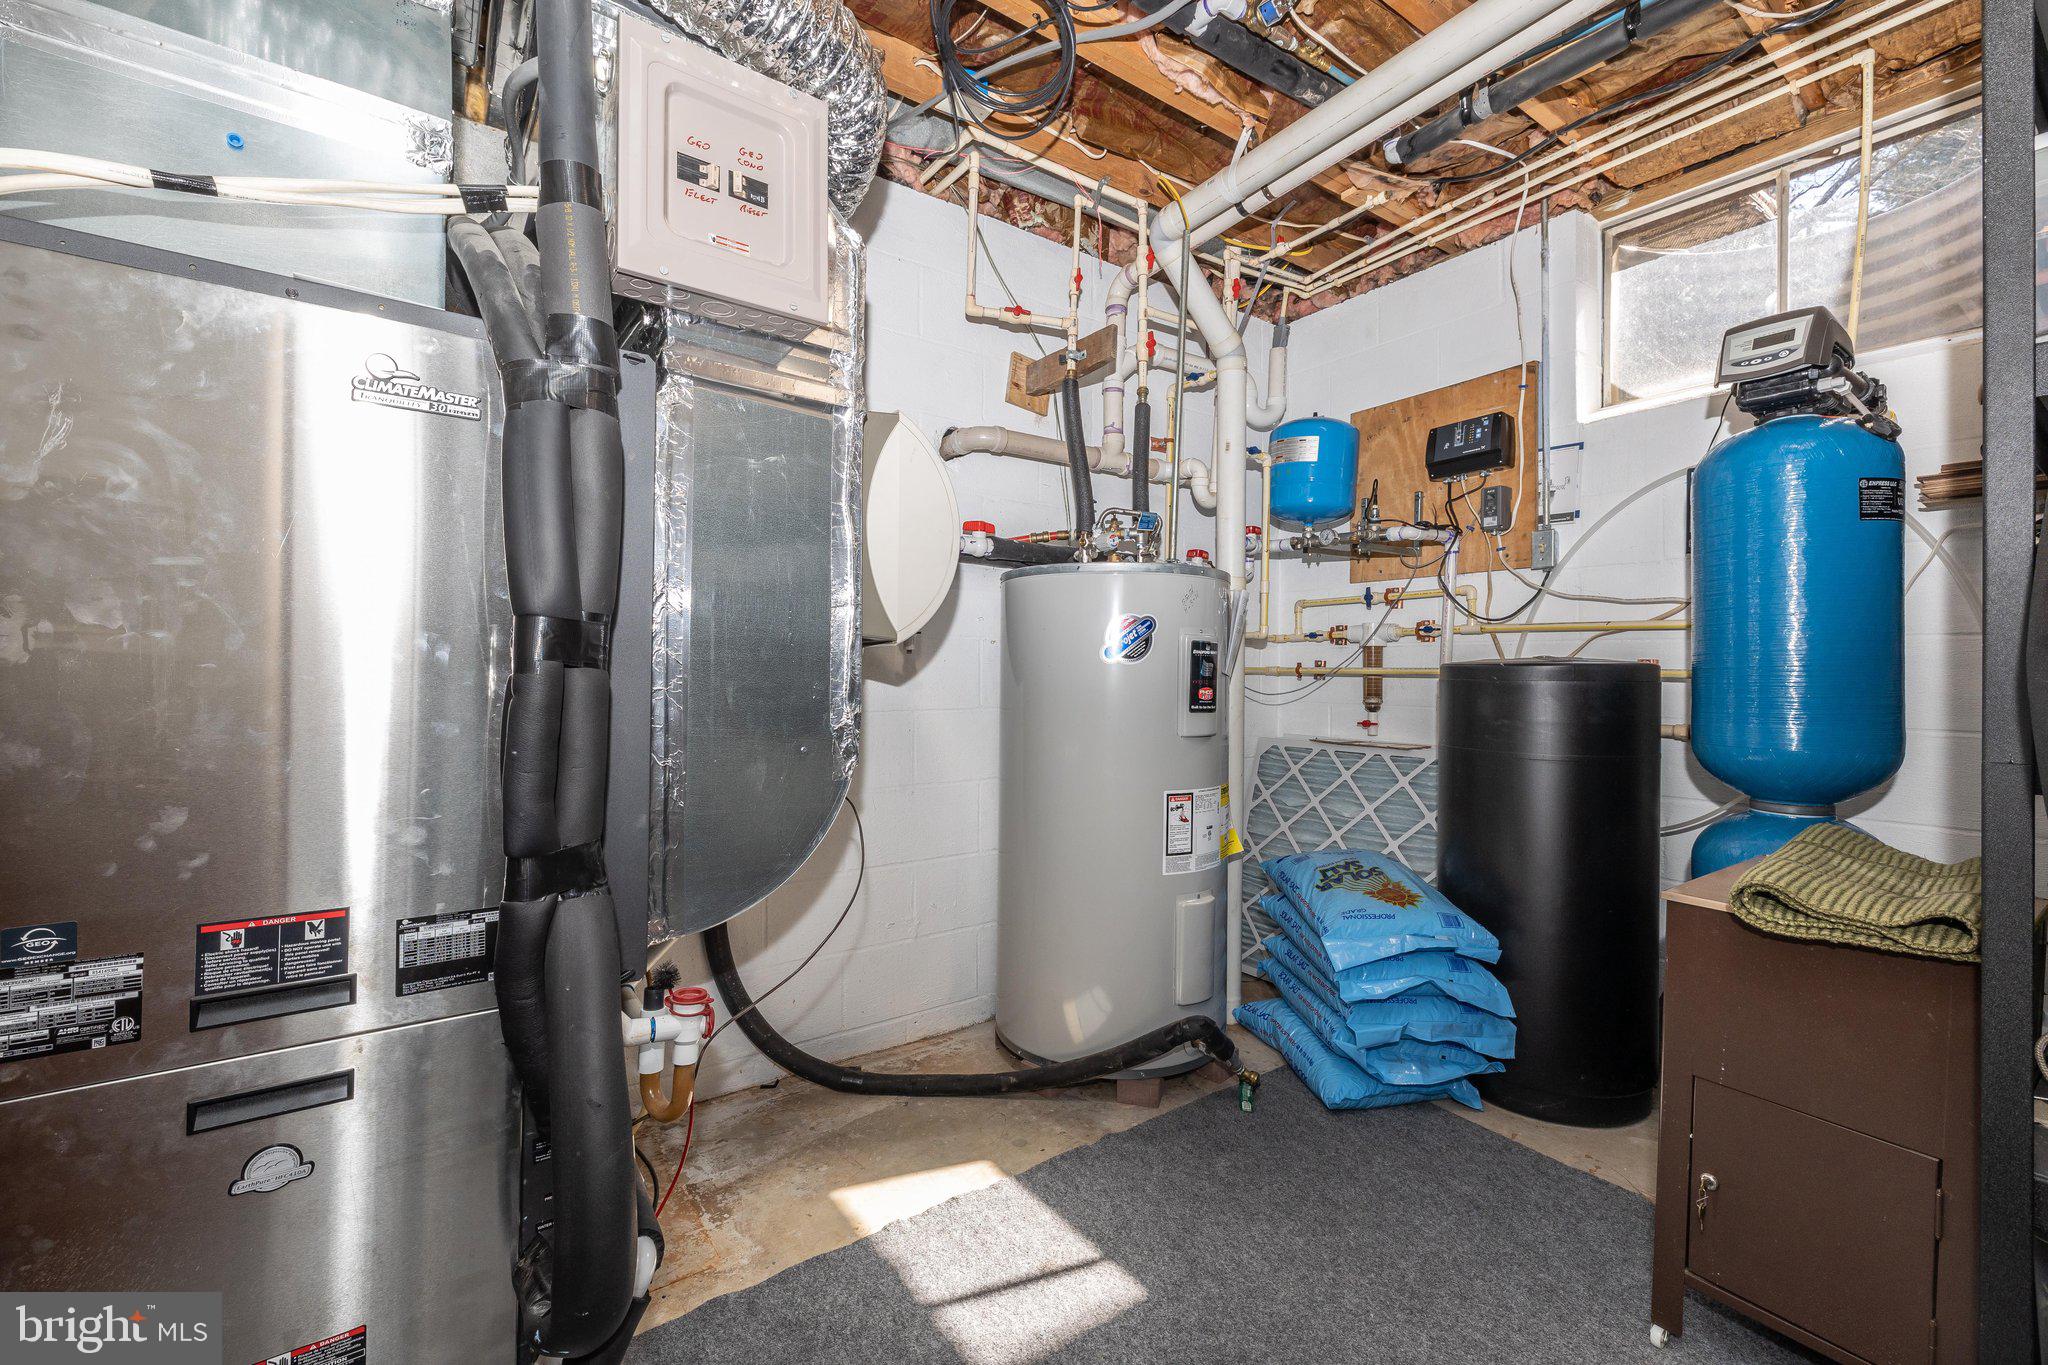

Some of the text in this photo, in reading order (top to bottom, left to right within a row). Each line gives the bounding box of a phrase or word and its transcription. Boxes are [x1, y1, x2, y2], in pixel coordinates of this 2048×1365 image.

[687, 136, 710, 150] GEO
[739, 147, 763, 160] GEO
[430, 402, 446, 412] 30
[1320, 860, 1363, 882] SALT
[1316, 866, 1384, 892] SOLAR
[262, 916, 296, 926] DANGER
[26, 940, 50, 948] GEO
[1, 951, 76, 964] www.GEOEXCHANGE.org
[320, 1332, 350, 1348] DANGER
